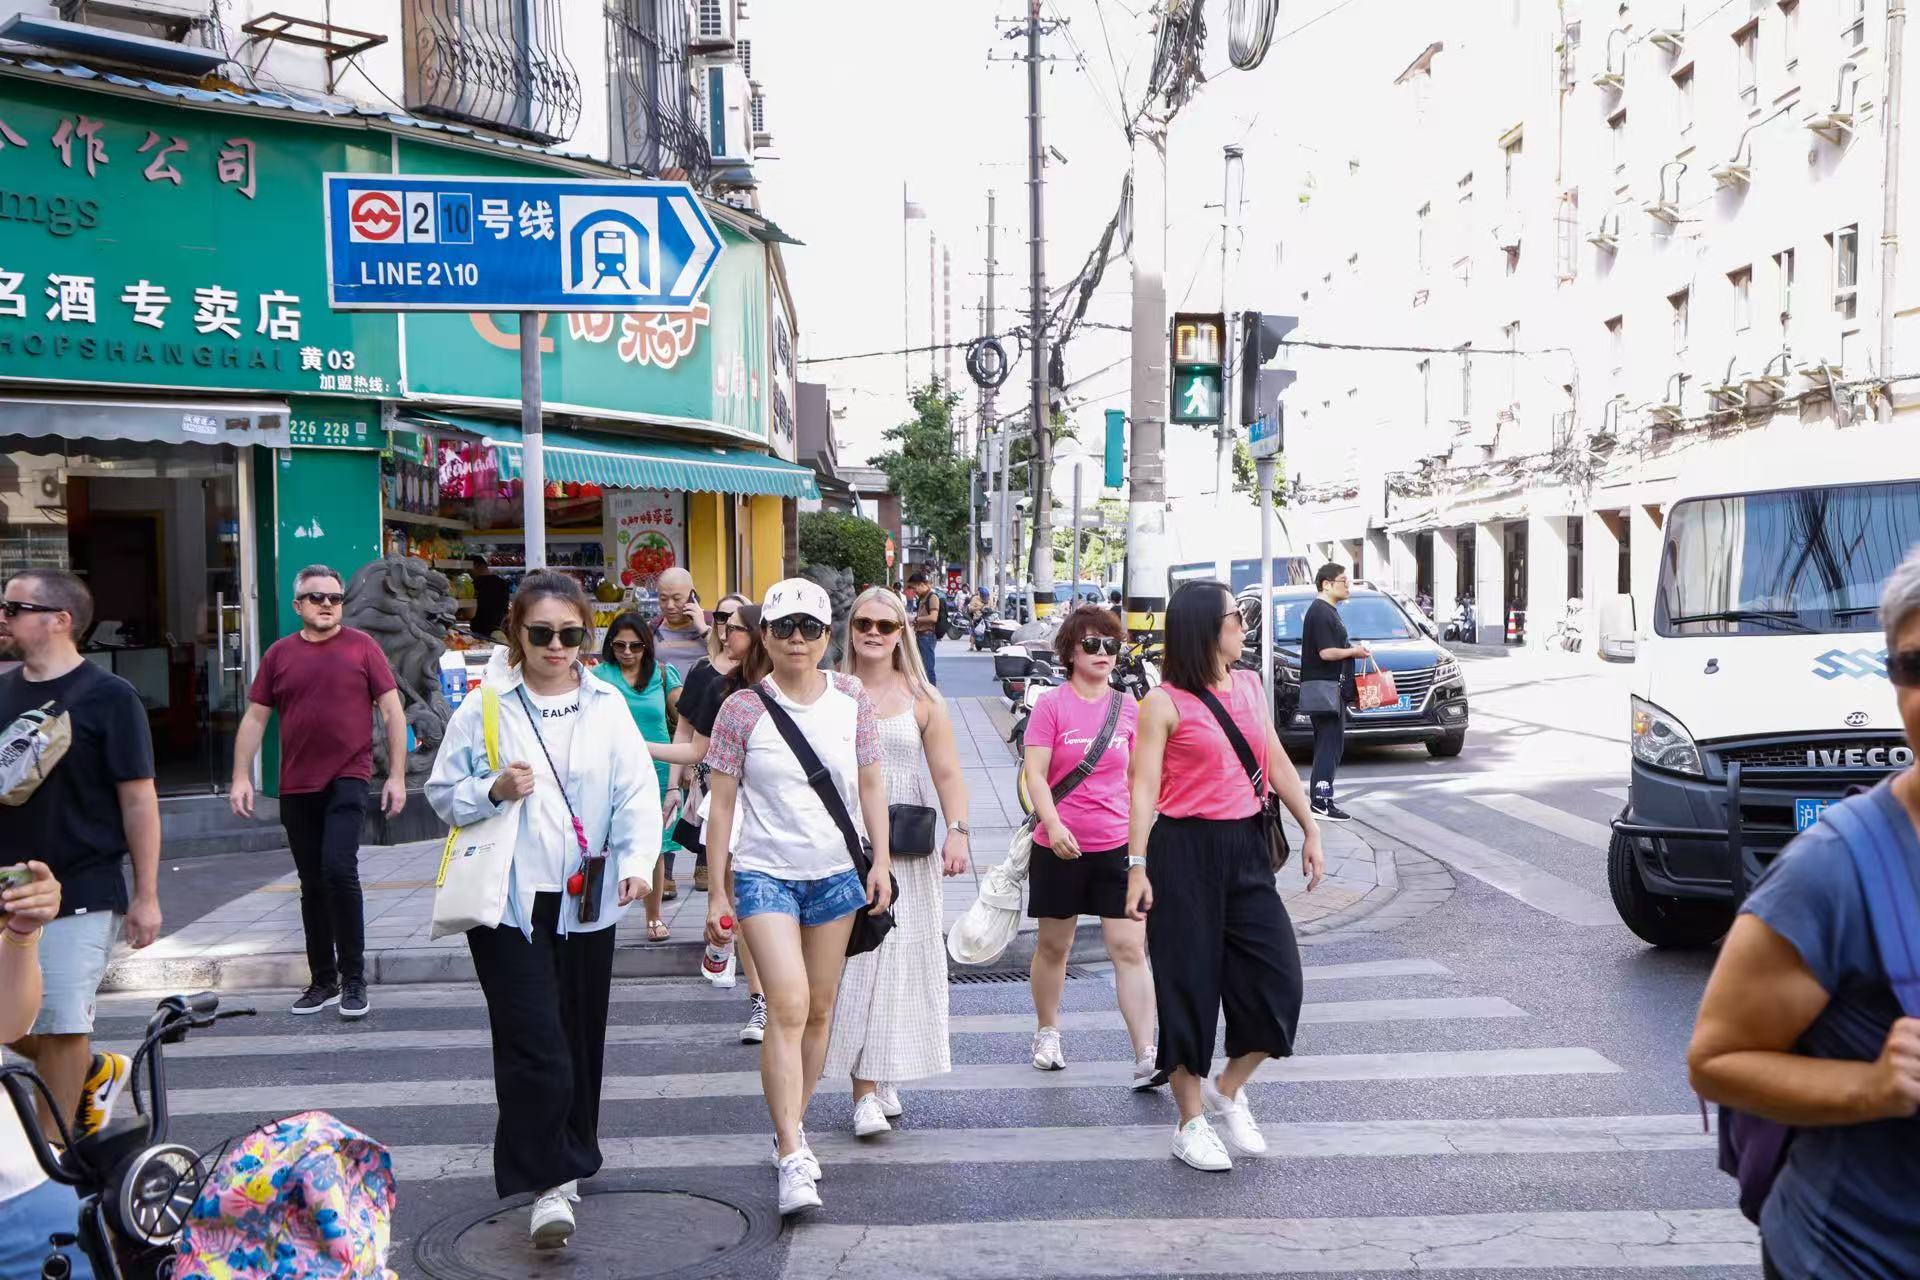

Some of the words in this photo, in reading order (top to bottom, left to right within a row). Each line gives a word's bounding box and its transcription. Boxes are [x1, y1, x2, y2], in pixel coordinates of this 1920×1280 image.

[412, 202, 430, 235] 2
[443, 203, 470, 235] 10
[477, 199, 556, 241] 号线
[360, 261, 423, 285] LINE
[0, 266, 300, 341] 名酒专卖店
[290, 420, 317, 435] 226
[323, 422, 350, 437] 228
[1060, 729, 1097, 755] Tommy
[1806, 747, 1914, 768] IVECO
